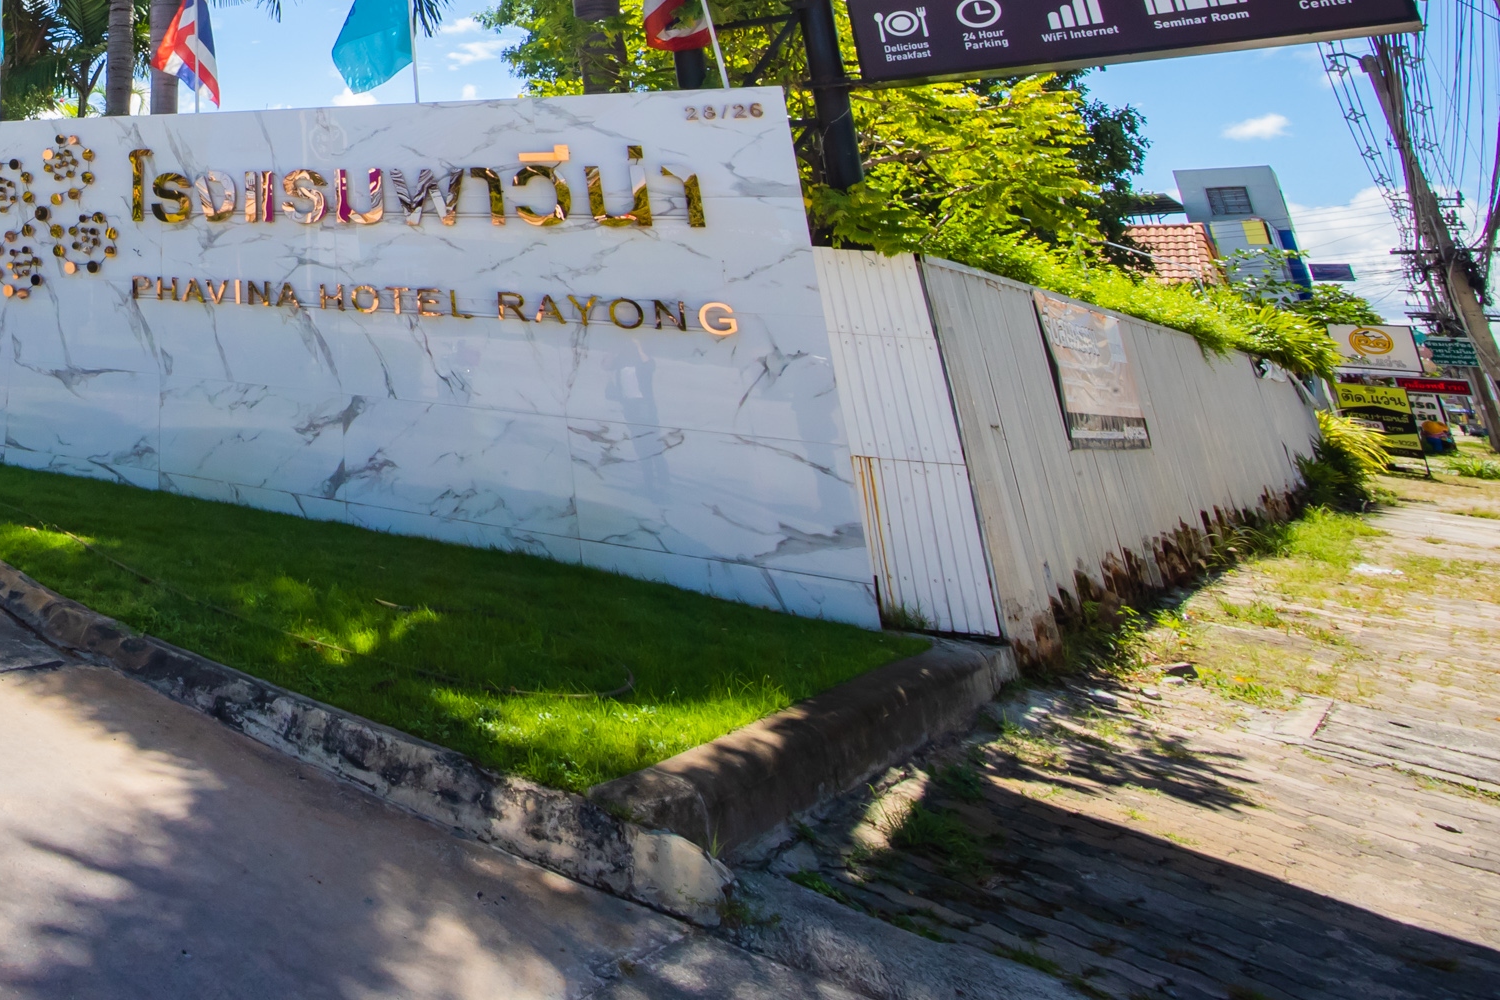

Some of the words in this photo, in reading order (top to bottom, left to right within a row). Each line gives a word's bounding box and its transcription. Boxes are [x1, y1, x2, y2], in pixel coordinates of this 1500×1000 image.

[1153, 17, 1208, 30] Seminar
[1211, 9, 1250, 23] Room
[962, 31, 980, 42] 24
[983, 28, 1005, 39] Hour
[1041, 31, 1066, 43] WiFi
[1069, 25, 1120, 40] Internet
[883, 41, 930, 54] Delicious
[964, 37, 1009, 51] Parking
[885, 49, 932, 62] Breakfast
[685, 103, 764, 121] 28/26
[129, 145, 706, 228] โรงแรมพาวีน่า
[132, 275, 301, 309] PHAVINA
[320, 283, 474, 319] HOTEL
[497, 291, 739, 337] RAYONG
